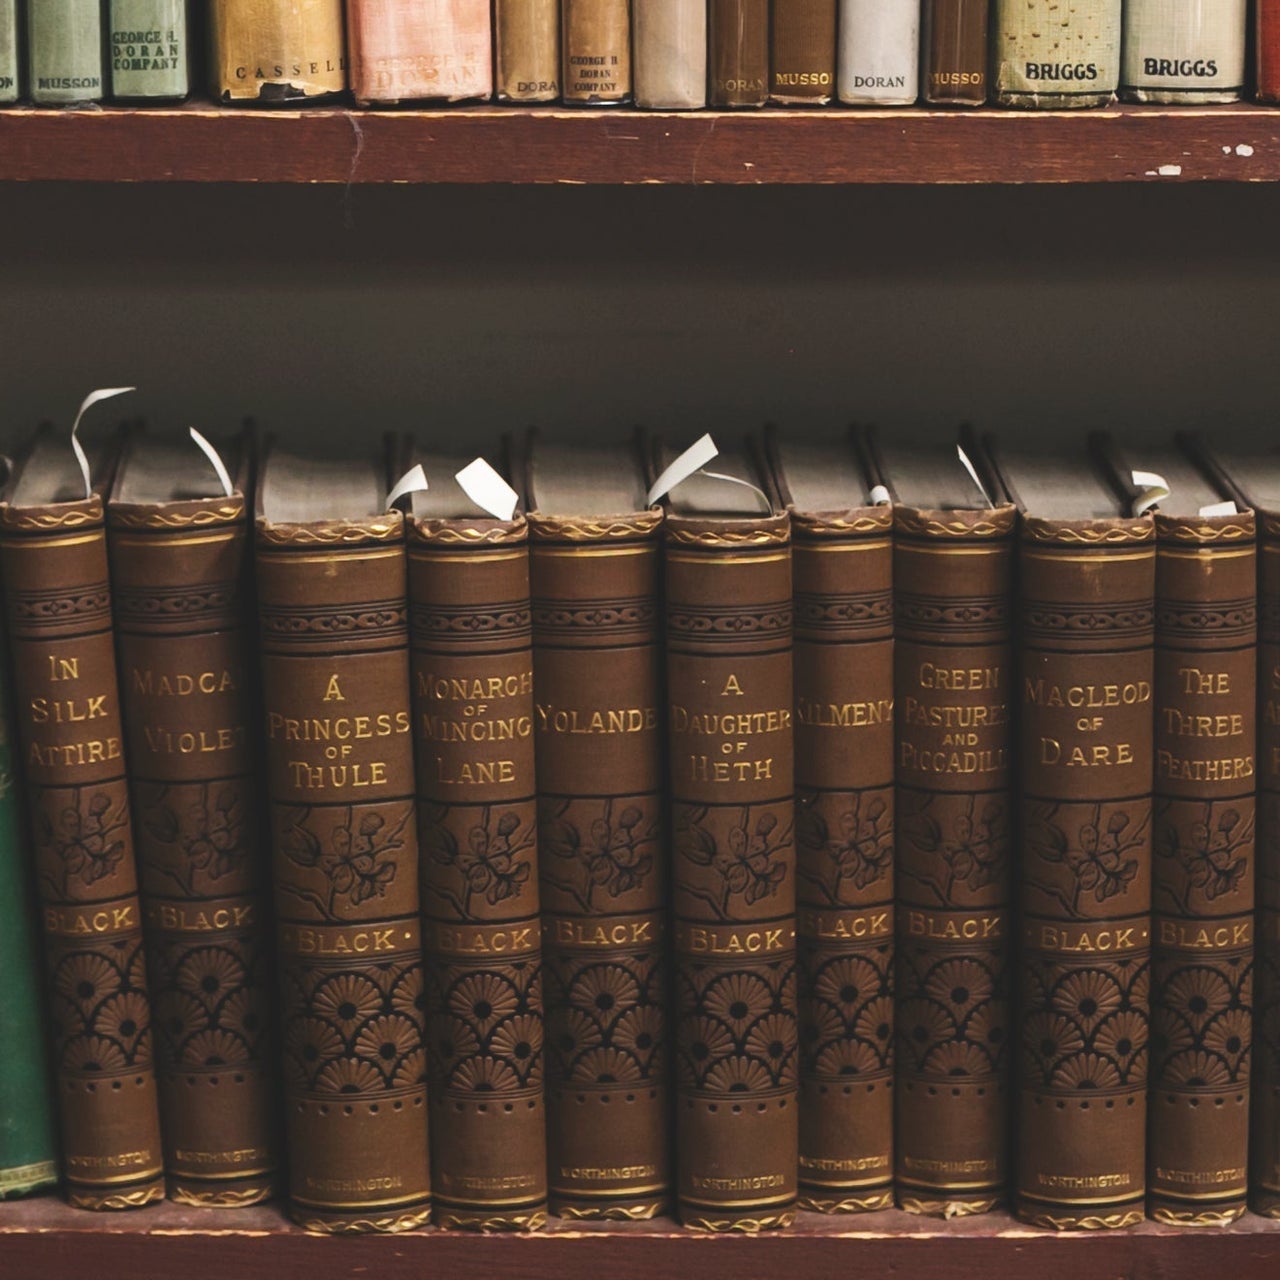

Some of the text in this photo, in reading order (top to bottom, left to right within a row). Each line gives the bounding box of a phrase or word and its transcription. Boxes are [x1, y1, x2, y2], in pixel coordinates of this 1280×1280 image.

[113, 57, 178, 71] COMPANY
[1026, 62, 1097, 81] BRIGGS
[1144, 57, 1218, 78] BRIGGS
[38, 77, 99, 90] MUSSON
[854, 75, 904, 88] DORAN
[49, 656, 79, 682] IN
[920, 663, 999, 691] GREEN
[323, 674, 344, 702] A
[721, 675, 744, 696] A
[1179, 668, 1230, 695] THE
[31, 696, 108, 722] SILK
[464, 705, 488, 717] OF
[270, 711, 410, 741] PRINCESS
[1077, 717, 1104, 732] OF
[1163, 708, 1243, 738] THREE
[721, 743, 748, 754] OF
[943, 733, 978, 746] AND
[325, 745, 353, 759] OF
[1041, 738, 1134, 767] DARE
[289, 762, 388, 788] THULE
